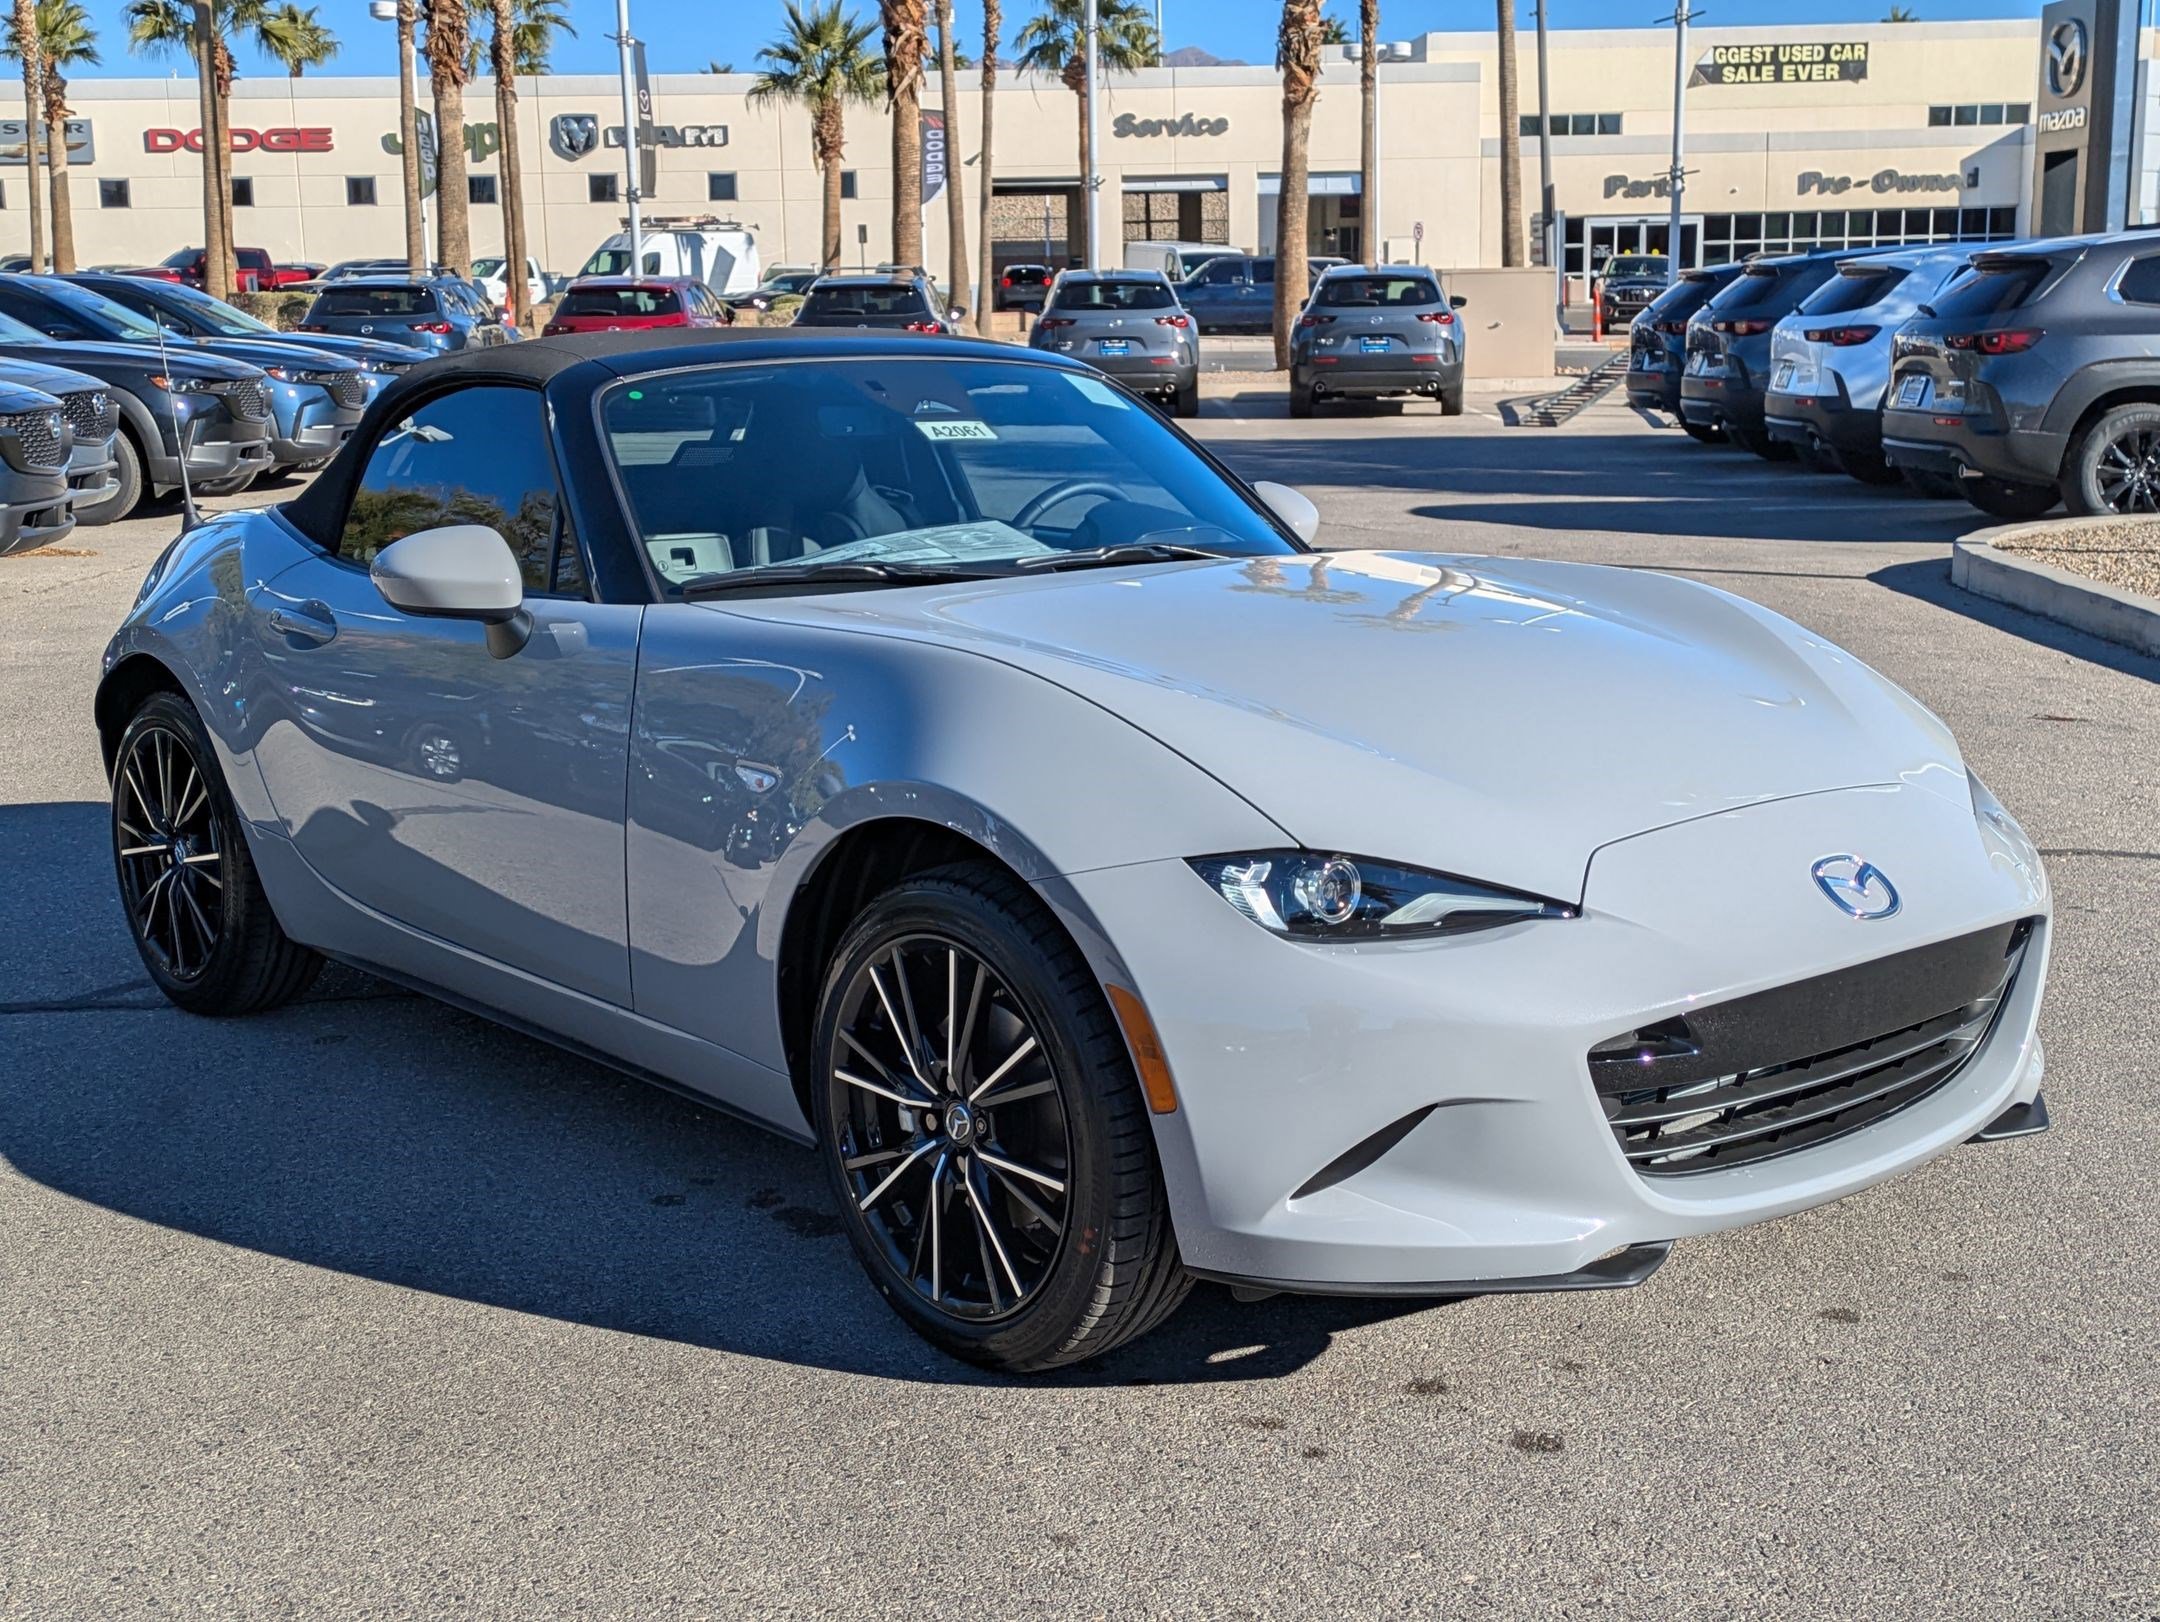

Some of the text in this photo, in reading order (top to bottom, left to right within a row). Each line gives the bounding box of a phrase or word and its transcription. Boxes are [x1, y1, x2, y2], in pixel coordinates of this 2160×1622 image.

[1714, 44, 1866, 64] GGEST USED CAR
[1722, 63, 1840, 83] SALE EVER
[1112, 112, 1229, 138] Service
[925, 129, 945, 184] DODGE
[1603, 174, 1685, 199] Part
[930, 425, 987, 438] A2061
